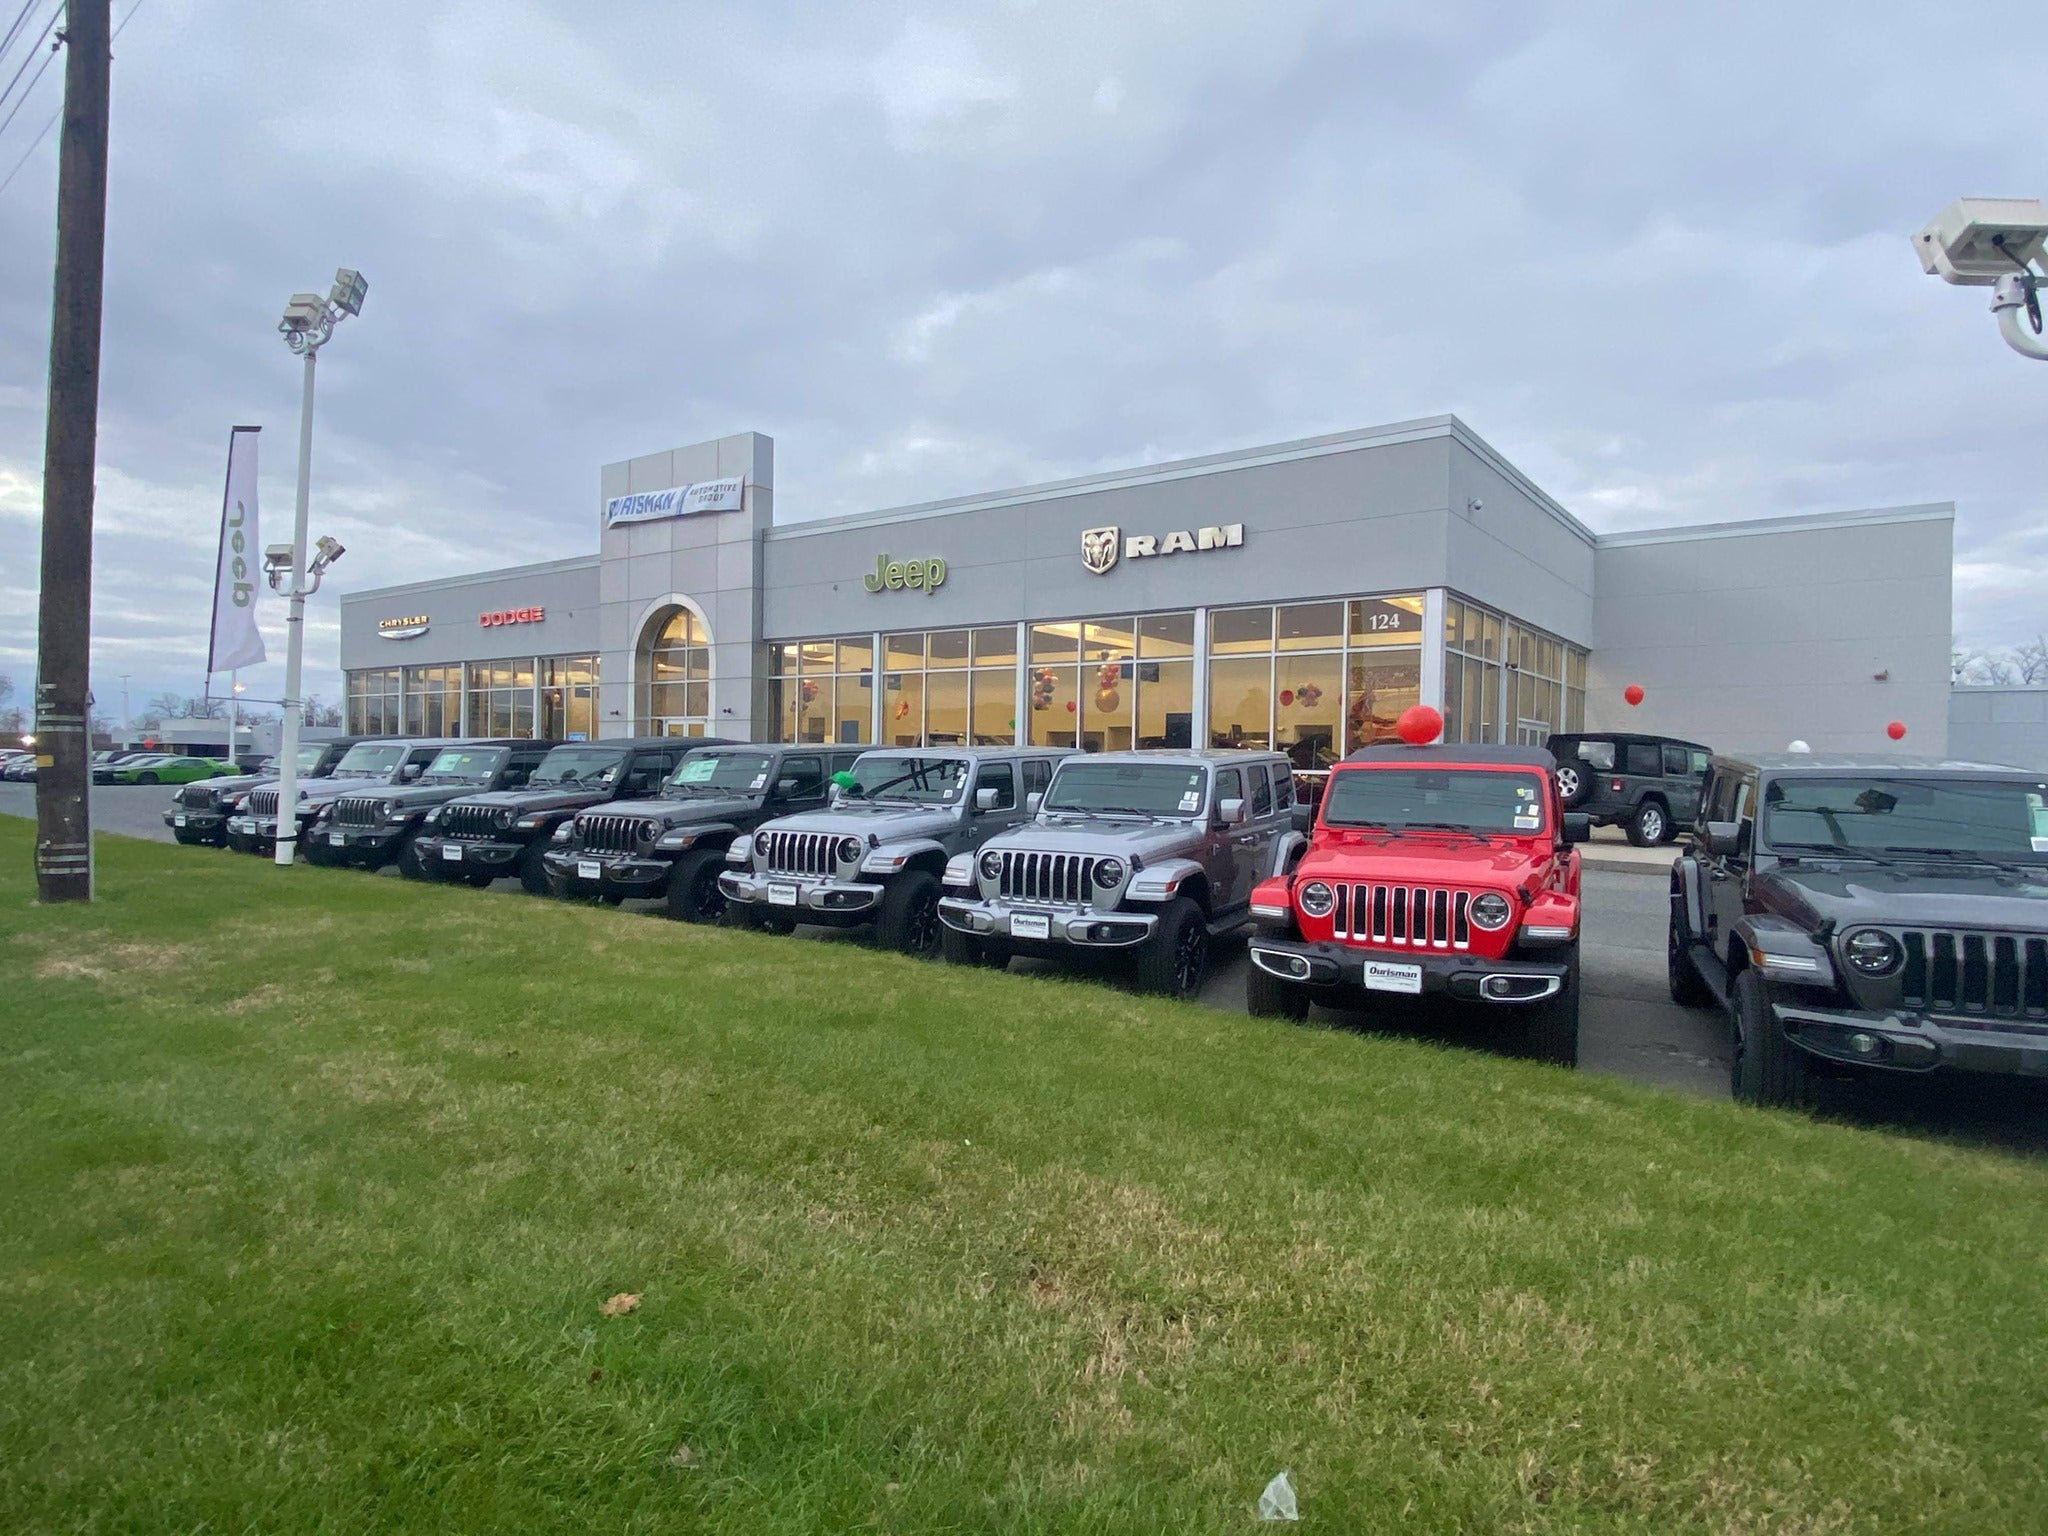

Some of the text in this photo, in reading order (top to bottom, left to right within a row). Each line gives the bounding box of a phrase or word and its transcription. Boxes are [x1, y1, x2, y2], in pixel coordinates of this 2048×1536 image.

[1125, 523, 1245, 559] RAM
[863, 554, 947, 594] Jeep
[379, 615, 429, 629] CHRYSLER
[479, 606, 545, 628] DODGE
[1369, 613, 1400, 630] 124
[1369, 966, 1418, 979] Ourisman
